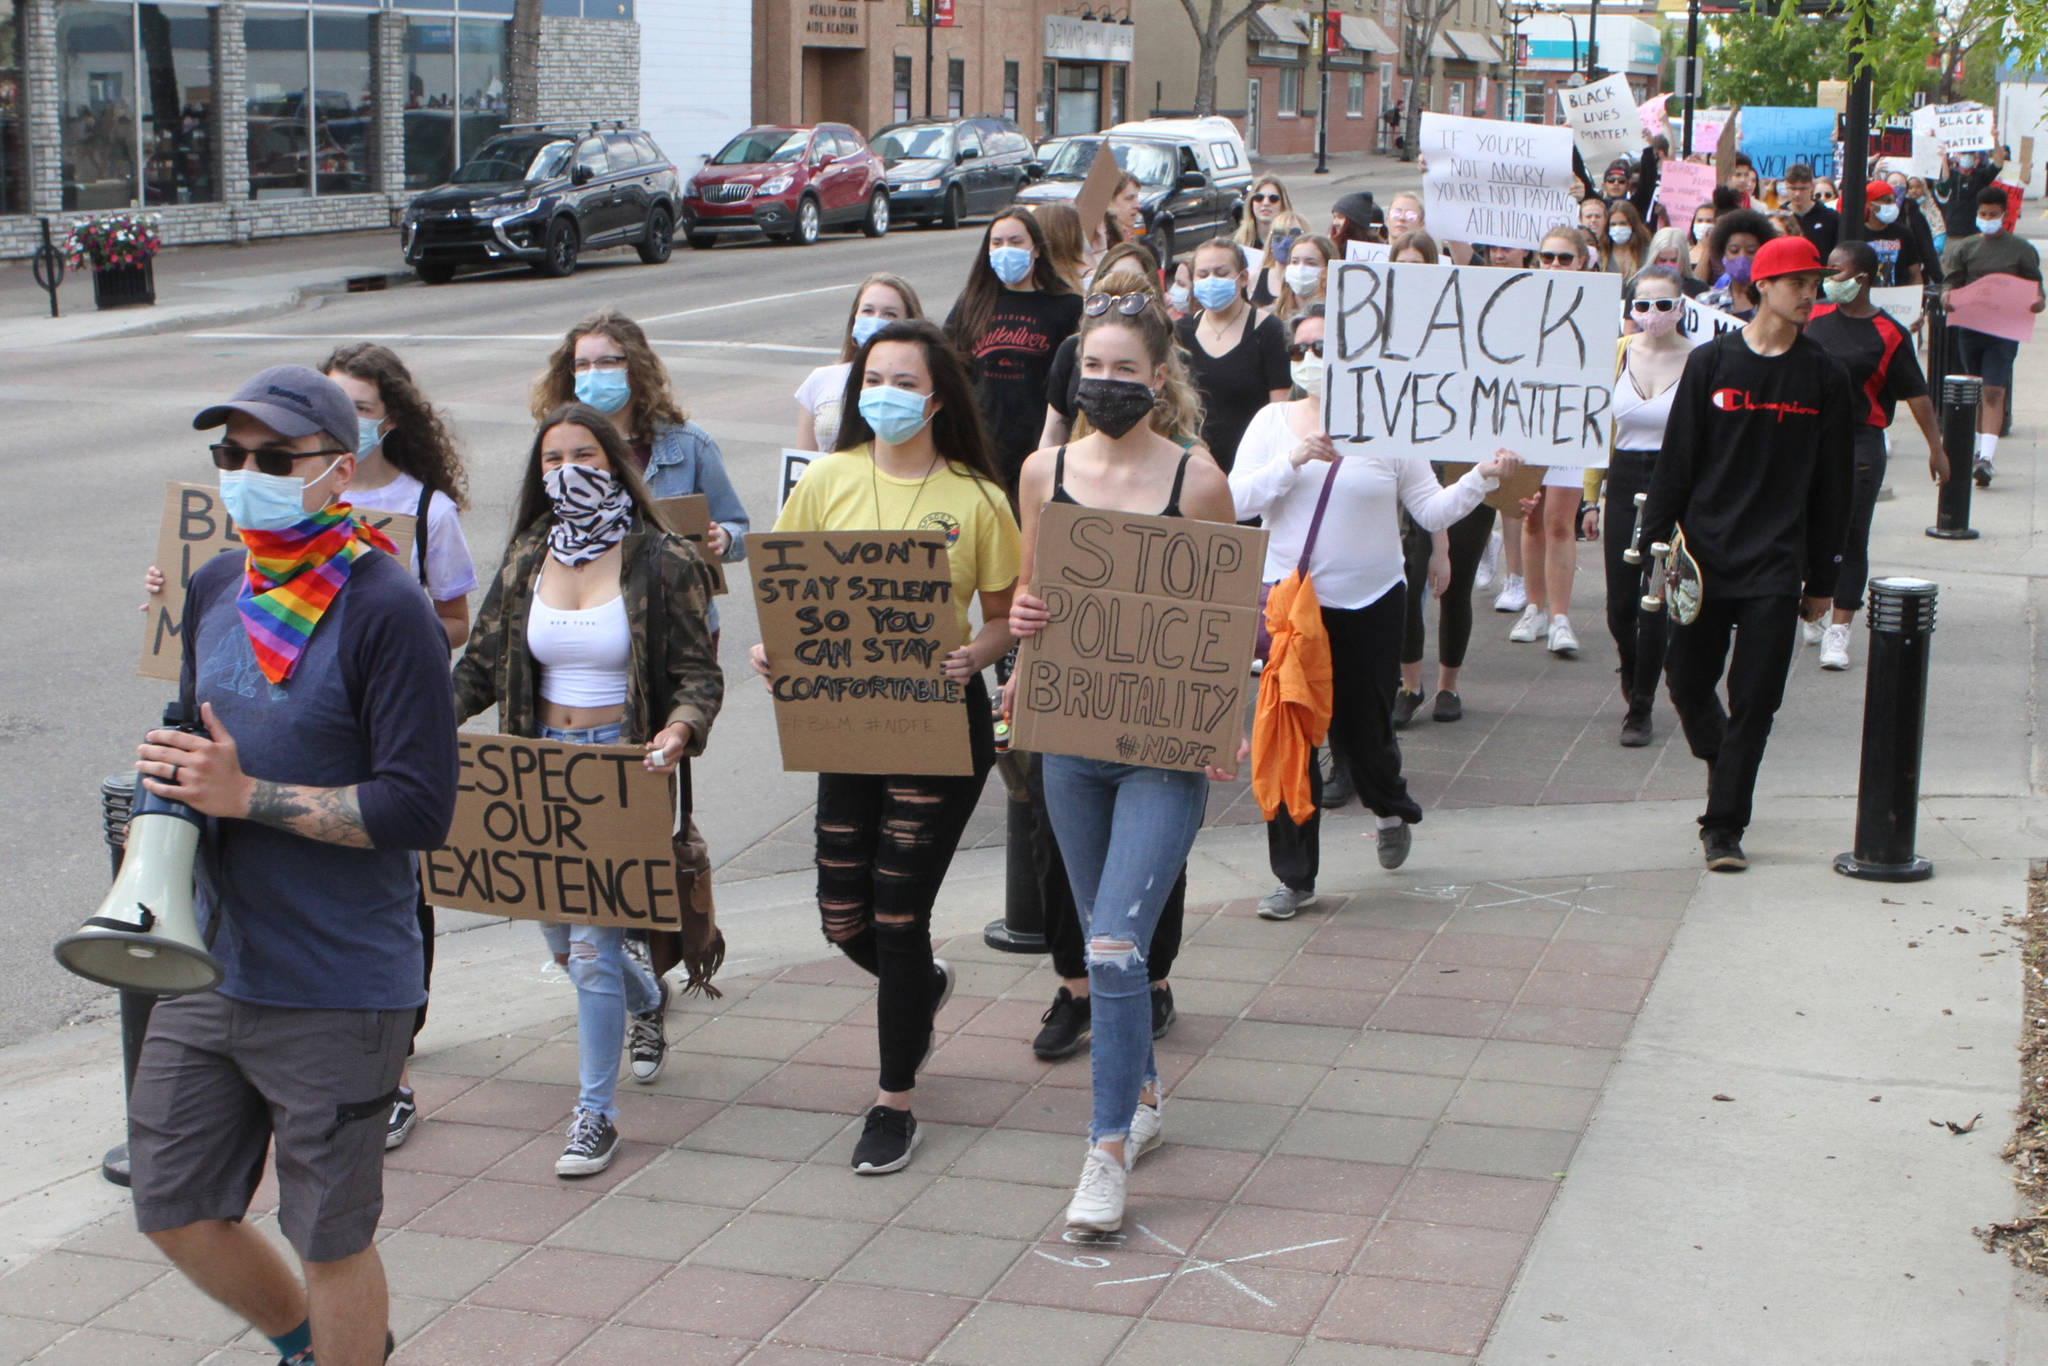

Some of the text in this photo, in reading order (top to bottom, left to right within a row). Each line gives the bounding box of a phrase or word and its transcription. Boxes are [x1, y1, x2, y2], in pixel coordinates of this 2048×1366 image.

[809, 4, 857, 18] HEALTH CARE
[806, 20, 859, 35] AIDE ACADEMY
[1568, 86, 1616, 108] BLACK
[1583, 108, 1620, 123] LIVES
[1939, 113, 1985, 128] BLACK
[1437, 129, 1540, 159] IF YOU'RE
[1580, 127, 1629, 140] MATTER
[1450, 158, 1545, 187] NOT ANGRY
[1488, 185, 1522, 208] NOT
[1523, 188, 1574, 213] PAYING
[1466, 207, 1542, 242] ATTENTION
[1337, 263, 1587, 371] BLACK
[1324, 363, 1611, 449] LIVES MATTER
[1711, 387, 1820, 423] Champion
[761, 537, 947, 572] I WON'T
[1061, 516, 1242, 602] STOP
[758, 576, 952, 603] STAY SILENT
[796, 606, 935, 635] SO YOU
[1032, 585, 1231, 673] POLICE
[794, 637, 941, 669] CAN STAY
[772, 675, 967, 704] COMFORTABLE.
[1026, 660, 1239, 733] BRUTALITY
[457, 741, 645, 808] ESPECT
[483, 800, 588, 851] OUR
[425, 845, 678, 924] EXISTENCE
